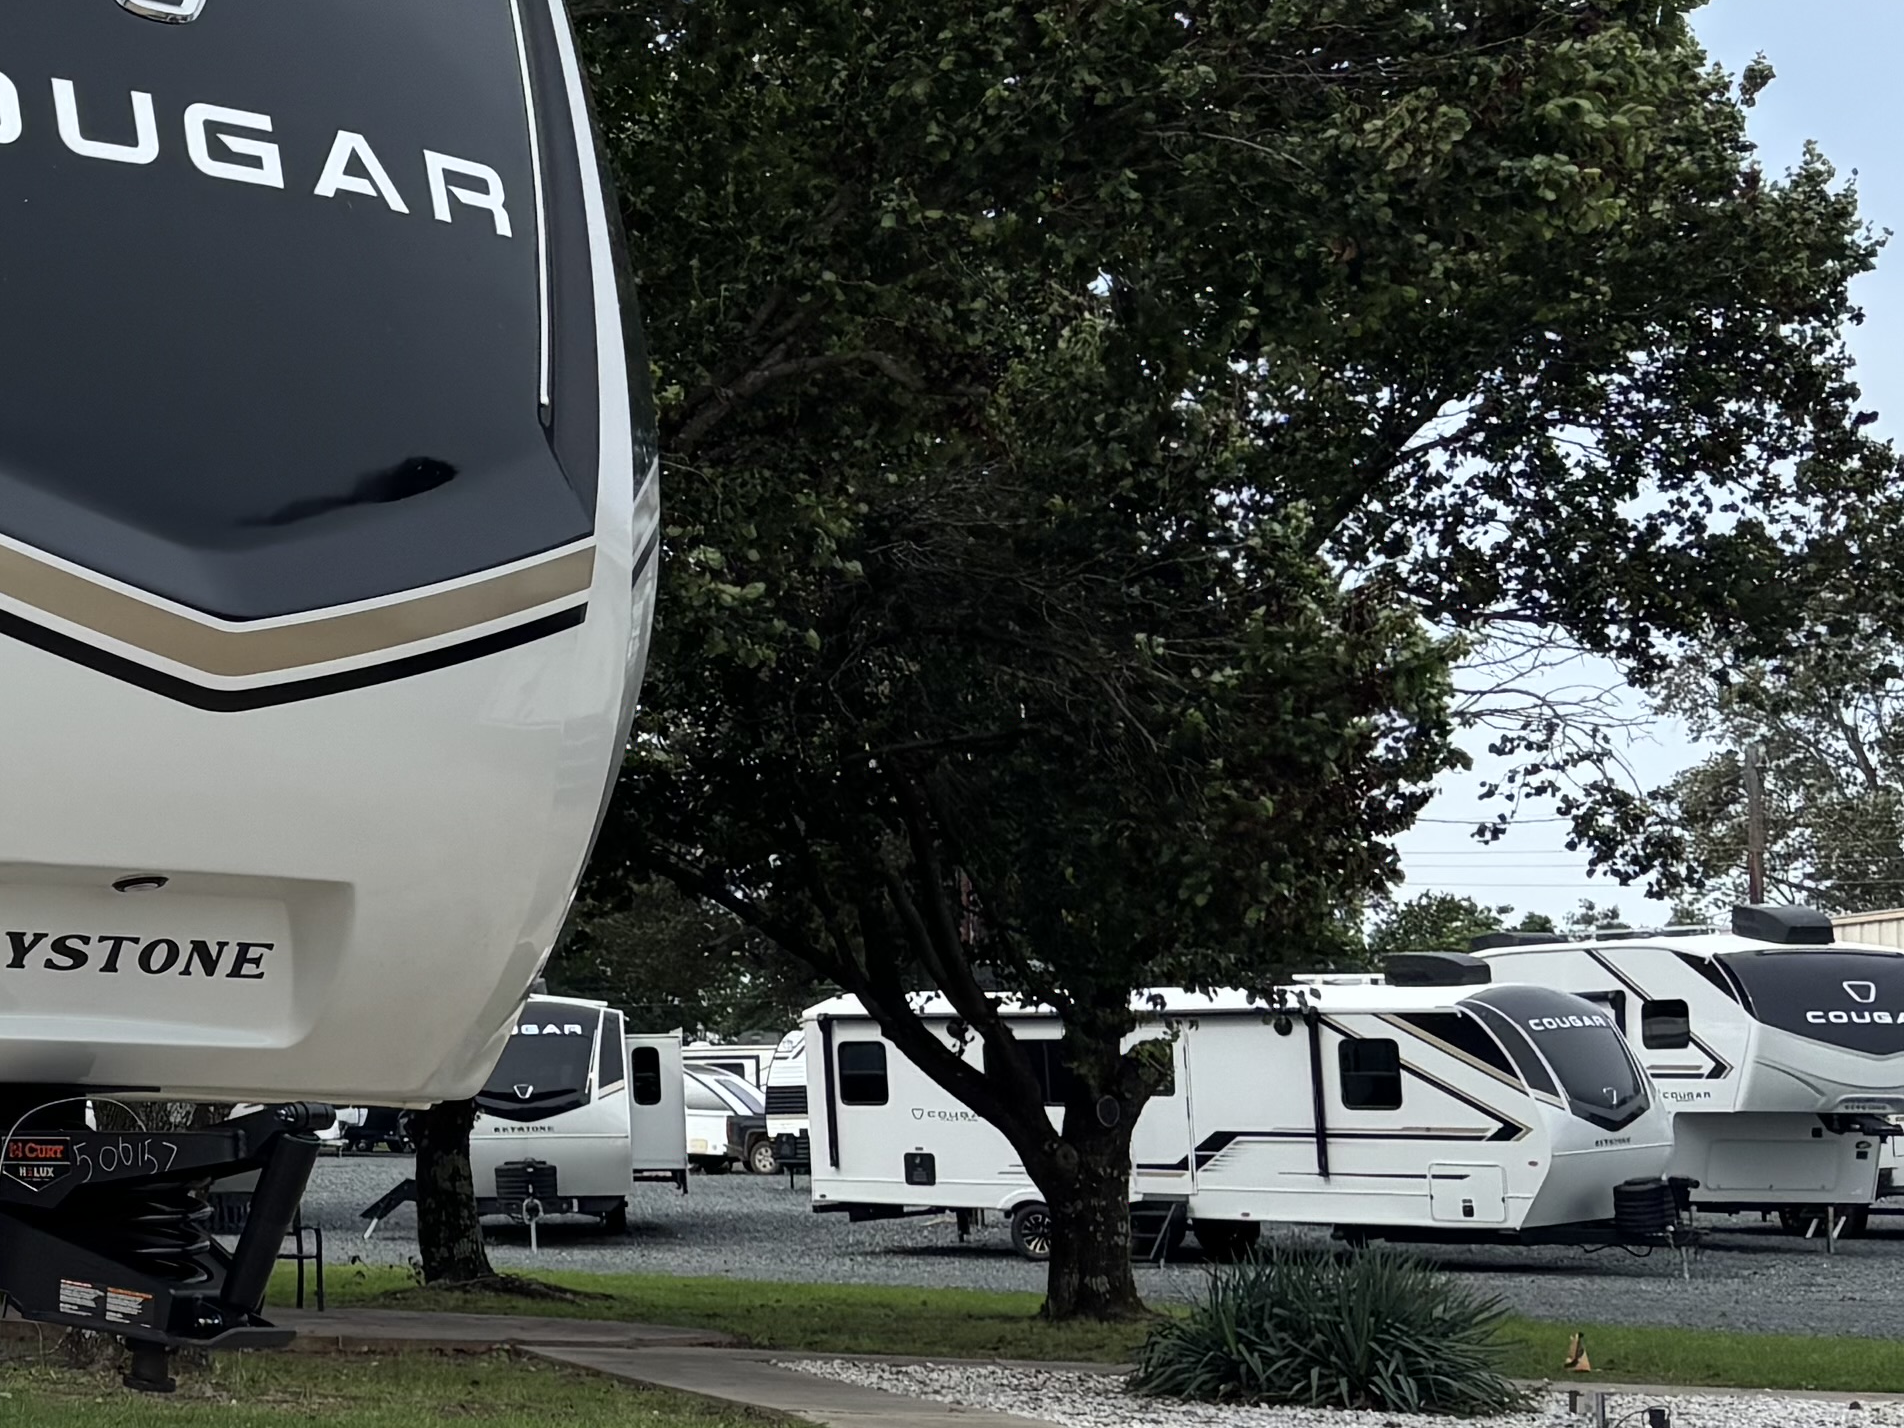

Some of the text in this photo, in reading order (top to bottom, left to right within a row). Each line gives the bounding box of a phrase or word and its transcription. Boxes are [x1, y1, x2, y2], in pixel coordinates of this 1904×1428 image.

[1528, 1015, 1607, 1031] COUGAR
[1805, 1010, 1904, 1024] COUG
[512, 1023, 583, 1035] GAR
[25, 1142, 64, 1158] CURT
